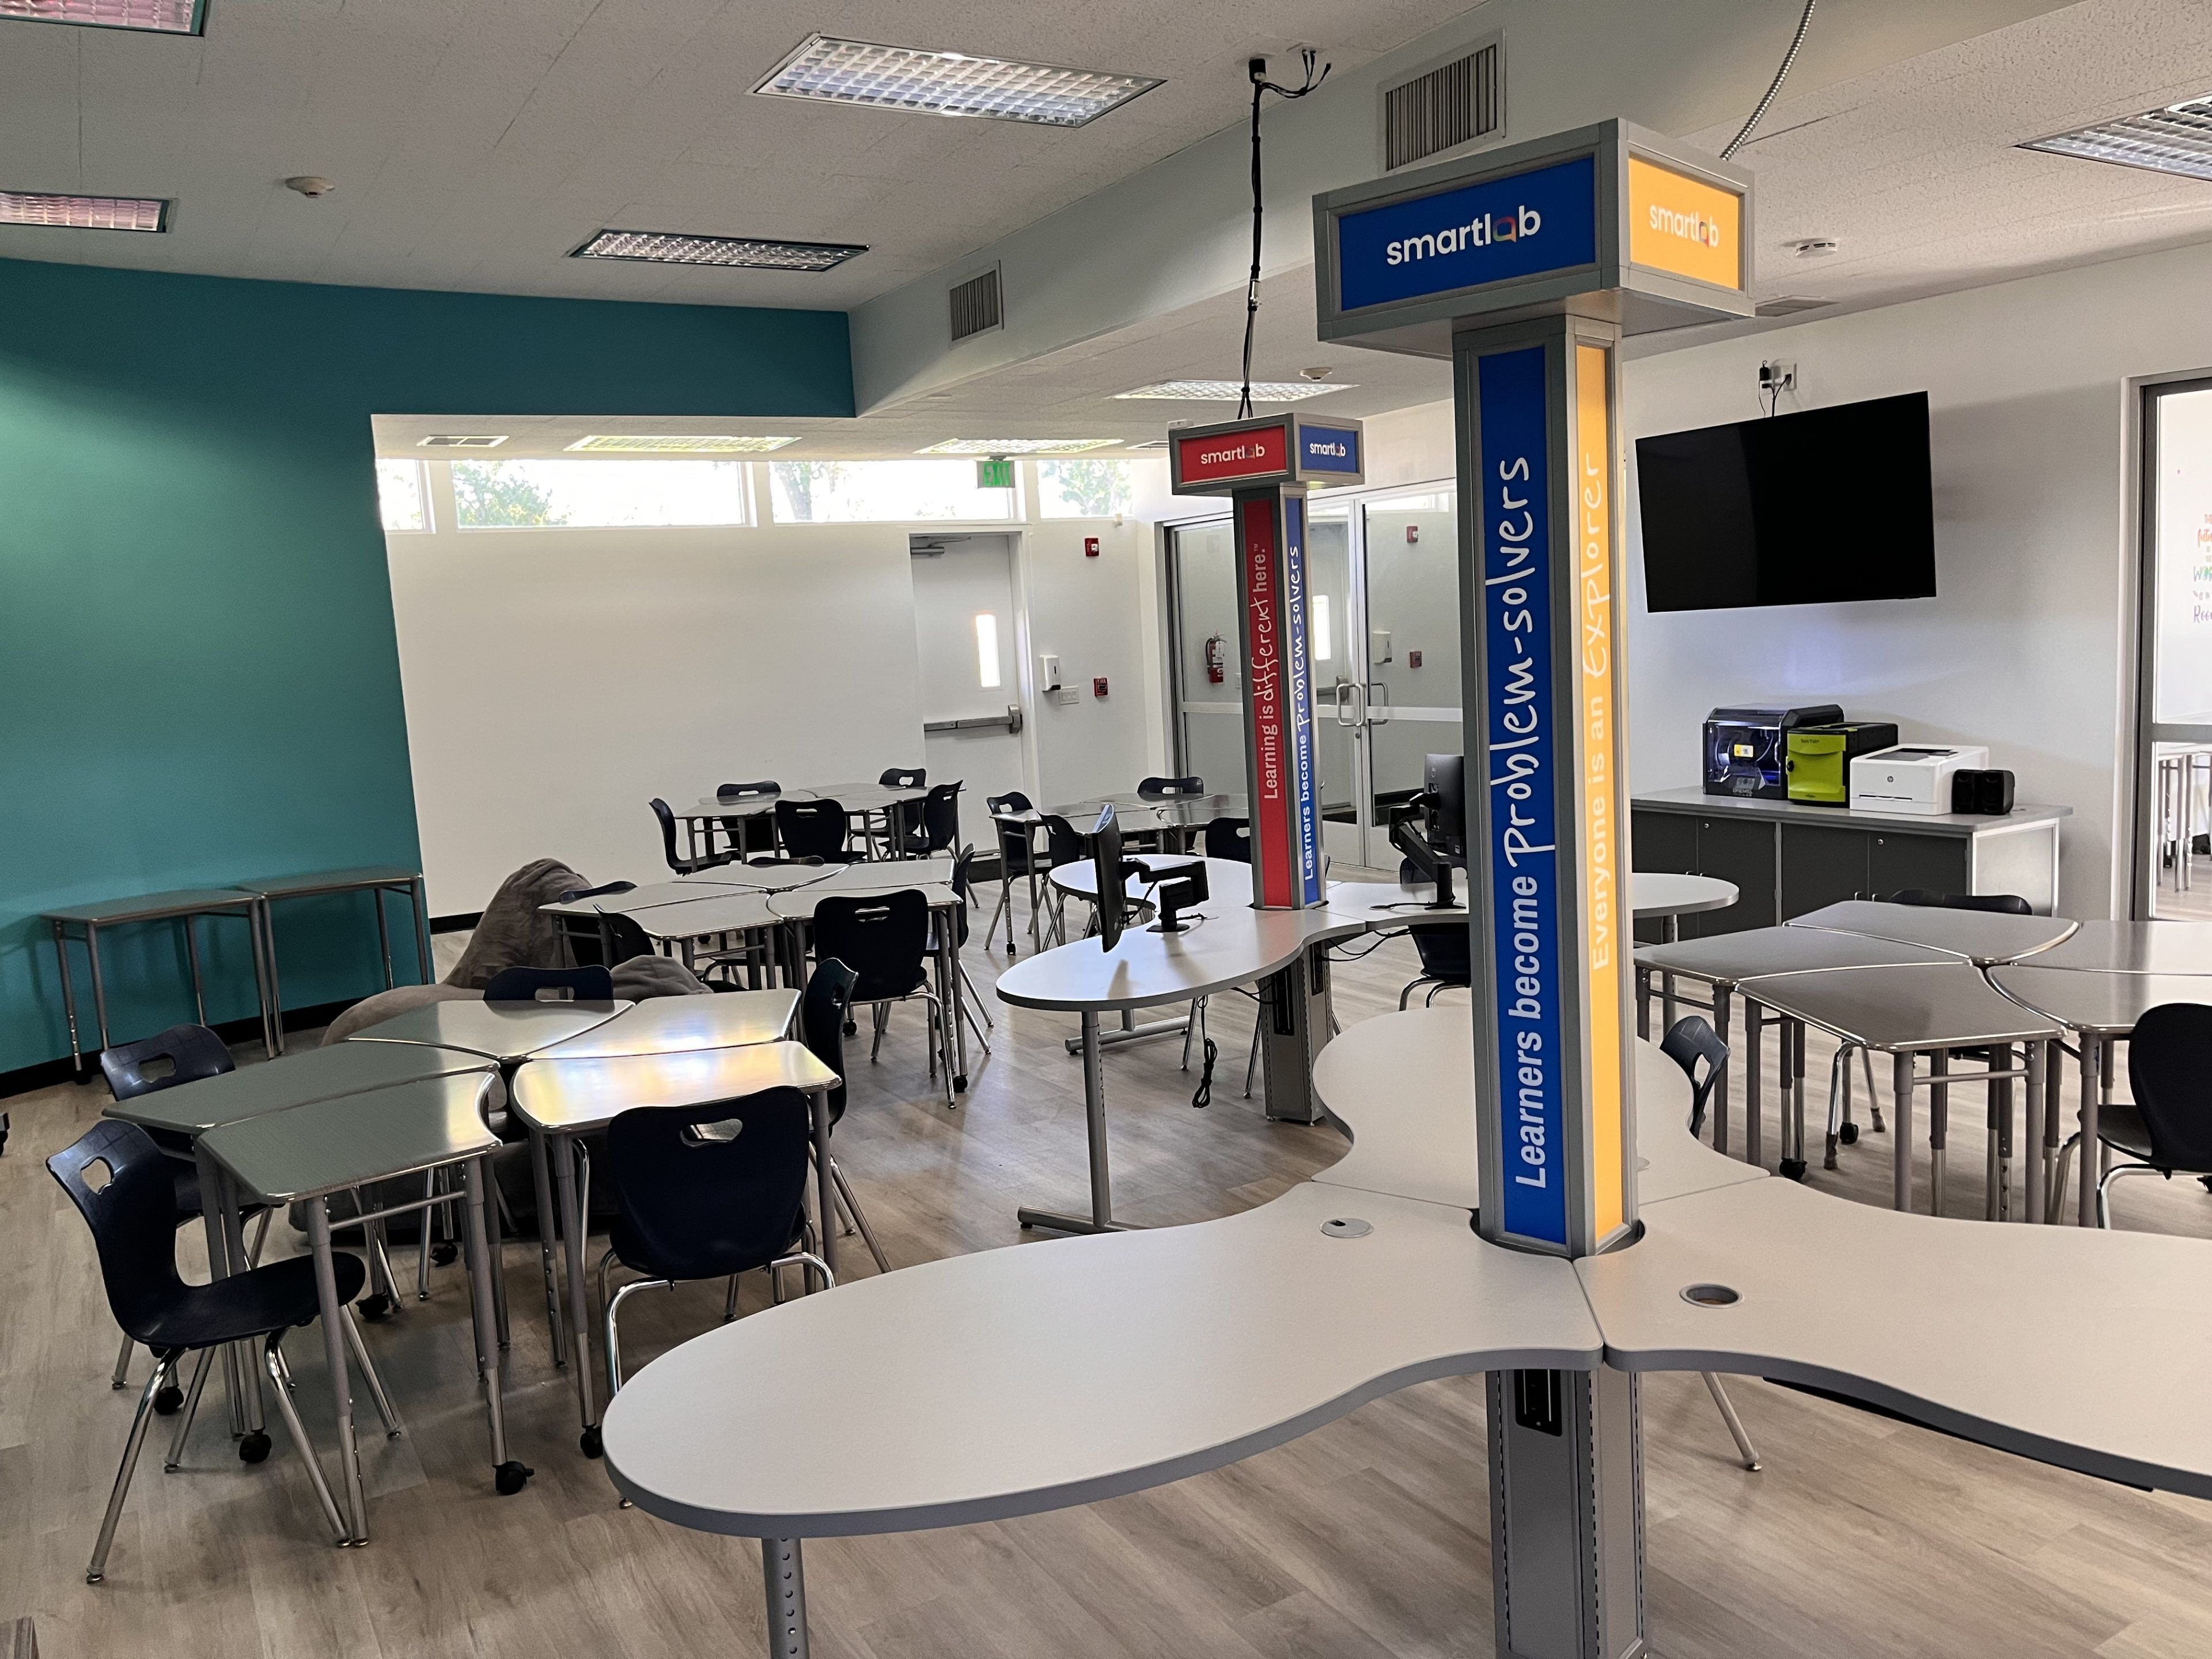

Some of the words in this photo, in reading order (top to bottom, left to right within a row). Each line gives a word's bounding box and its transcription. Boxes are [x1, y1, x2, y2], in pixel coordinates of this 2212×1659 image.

[1386, 205, 1541, 266] smartlab
[1649, 204, 1719, 249] smartlab
[983, 461, 1010, 486] EXIT
[1200, 443, 1266, 465] smartlab
[1309, 442, 1346, 457] smartlab
[1249, 596, 1279, 702] different
[1259, 704, 1274, 719] is
[1590, 695, 1604, 740] an
[1261, 724, 1278, 800] Learning
[1298, 734, 1309, 802] become
[1588, 751, 1605, 785] is
[1300, 806, 1313, 881] Learners
[1592, 796, 1611, 970] Everyone
[1508, 876, 1541, 1020] become
[1515, 1030, 1547, 1189] Learners
